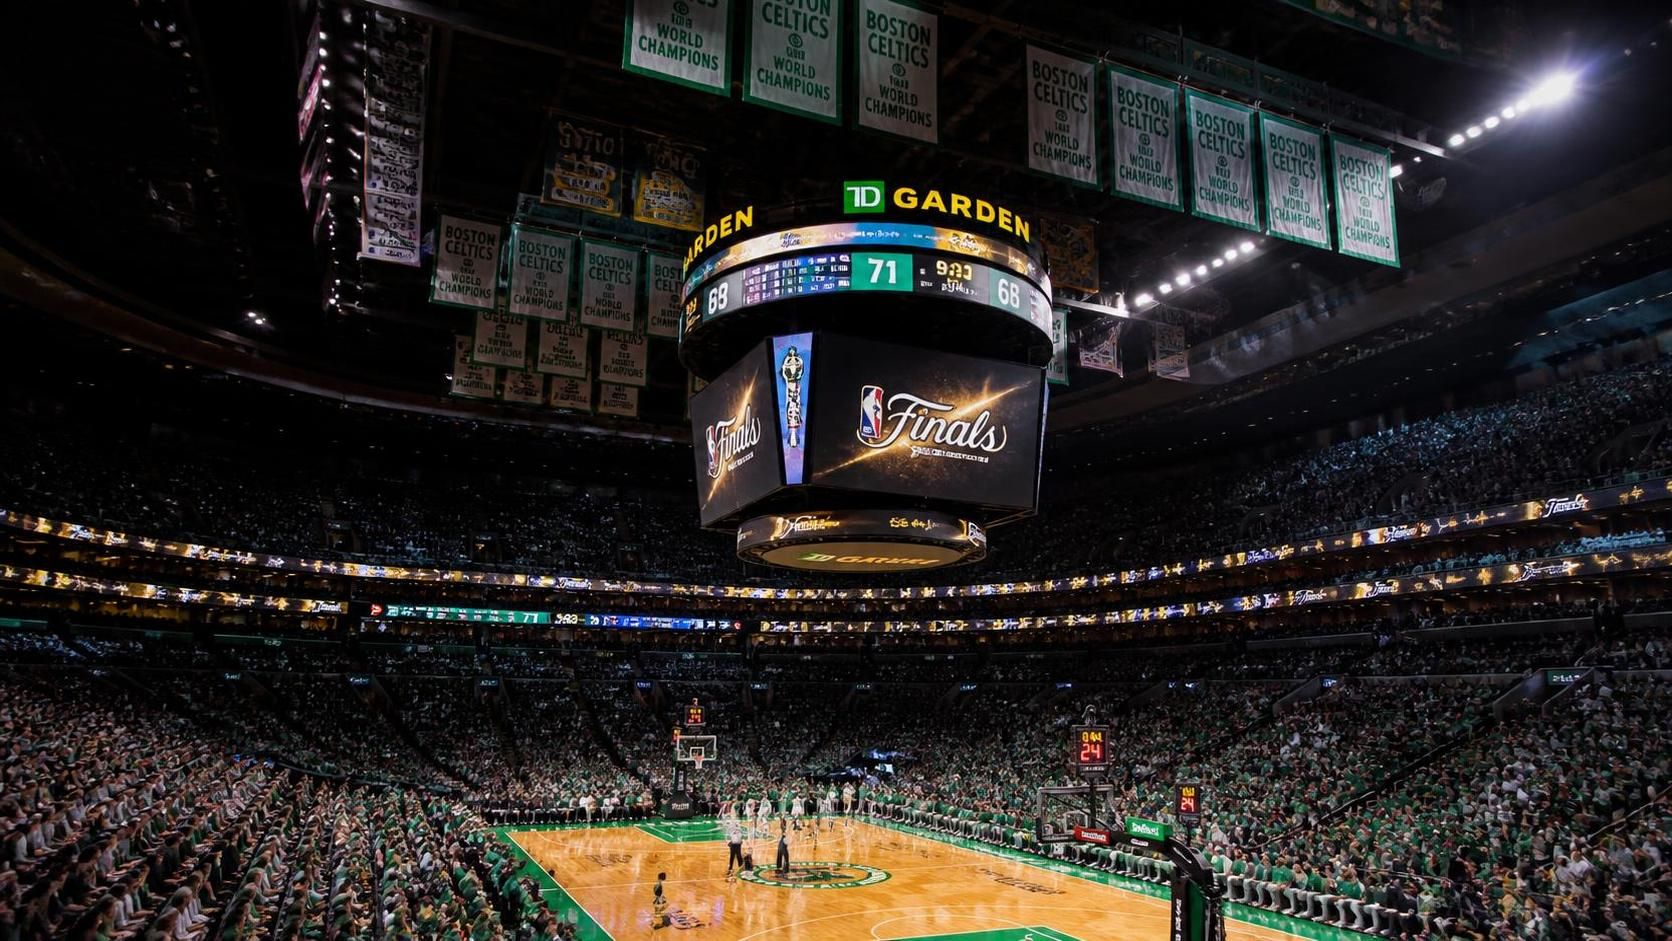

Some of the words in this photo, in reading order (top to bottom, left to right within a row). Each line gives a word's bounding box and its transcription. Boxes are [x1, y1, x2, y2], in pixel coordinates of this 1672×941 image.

[762, 2, 829, 39] CELTICS
[866, 10, 931, 46] BOSTON
[657, 23, 703, 48] WORLD
[638, 35, 719, 71] CHAMPIONS
[868, 33, 929, 68] CELTICS
[773, 56, 816, 79] WORLD
[1032, 60, 1088, 93] BOSTON
[757, 68, 830, 100] CHAMPIONS
[879, 84, 918, 107] WORLD
[1034, 82, 1088, 114] CELTICS
[1117, 86, 1169, 118] BOSTON
[865, 97, 932, 128] CHAMPIONS
[1119, 107, 1169, 138] CELTICS
[1195, 111, 1245, 140] BOSTON
[1044, 130, 1079, 151] WORLD
[1198, 130, 1245, 160] CELTICS
[1269, 133, 1316, 161] BOSTON
[1033, 142, 1092, 170] CHAMPIONS
[1129, 154, 1161, 173] WORLD
[1272, 152, 1316, 181] CELTICS
[1339, 154, 1384, 182] BOSTON
[1119, 165, 1174, 192] CHAMPIONS
[1208, 175, 1238, 194] WORLD
[1342, 173, 1385, 200] CELTICS
[1199, 186, 1250, 212] CHAMPIONS
[1282, 196, 1311, 214] WORLD
[846, 186, 881, 208] TD
[893, 187, 1030, 243] GARDEN
[1274, 207, 1322, 232] CHAMPIONS
[1352, 216, 1380, 233] WORLD
[446, 226, 496, 246] BOSTON
[1345, 226, 1390, 249] CHAMPIONS
[445, 240, 493, 260] CELTICS
[519, 240, 566, 259] BOSTON
[589, 253, 633, 272] BOSTON
[519, 254, 563, 274] CELTICS
[589, 266, 631, 285] CELTICS
[655, 264, 683, 280] BOST
[868, 258, 896, 284] 71
[655, 278, 683, 293] CELT
[708, 282, 729, 315] 68
[856, 393, 1007, 452] Finals
[708, 405, 761, 478] Finals
[1080, 743, 1101, 761] 24
[1181, 797, 1194, 812] 24
